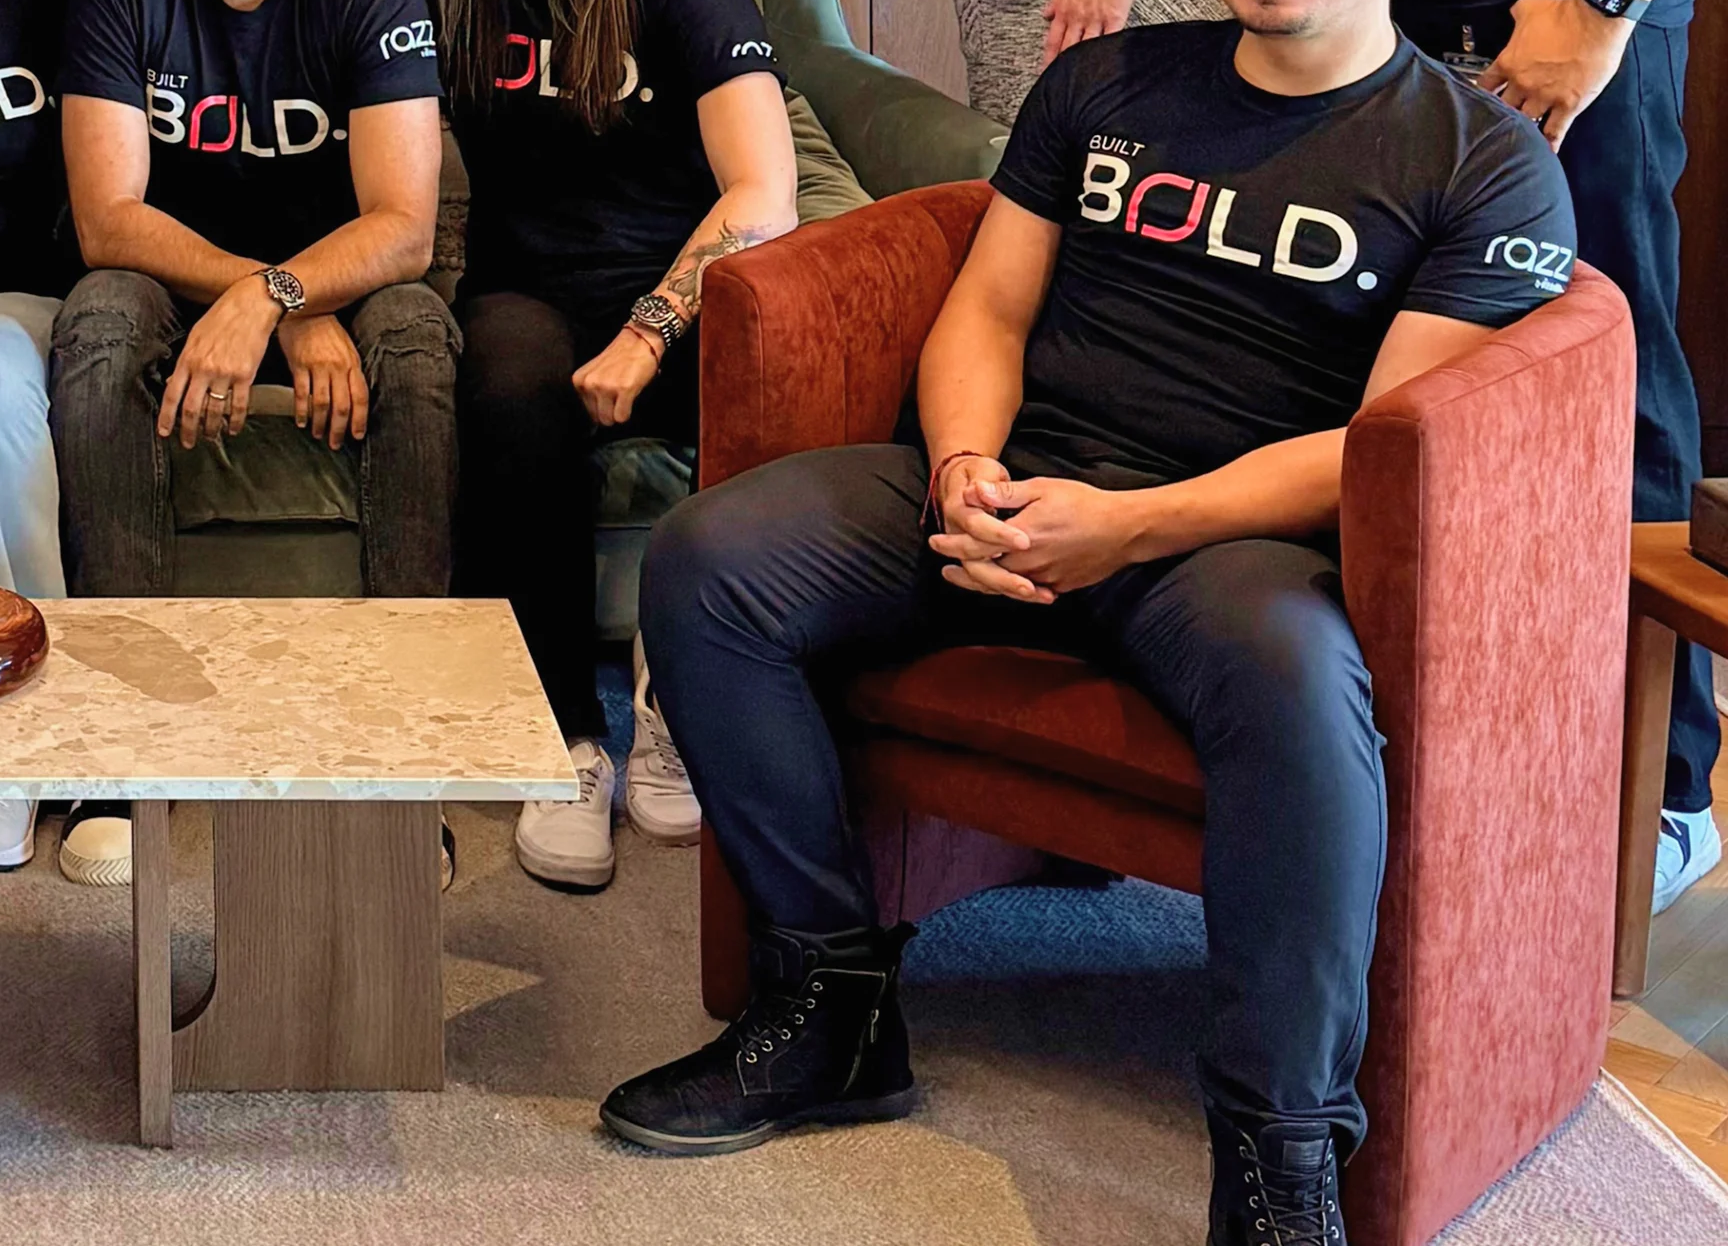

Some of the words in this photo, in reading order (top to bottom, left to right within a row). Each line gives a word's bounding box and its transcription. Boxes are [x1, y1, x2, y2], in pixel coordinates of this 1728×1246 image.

[379, 19, 436, 60] razz
[145, 83, 348, 158] BOLD.
[1089, 134, 1146, 157] BUILT
[1077, 152, 1378, 291] BOLD.
[1484, 235, 1572, 283] razz
